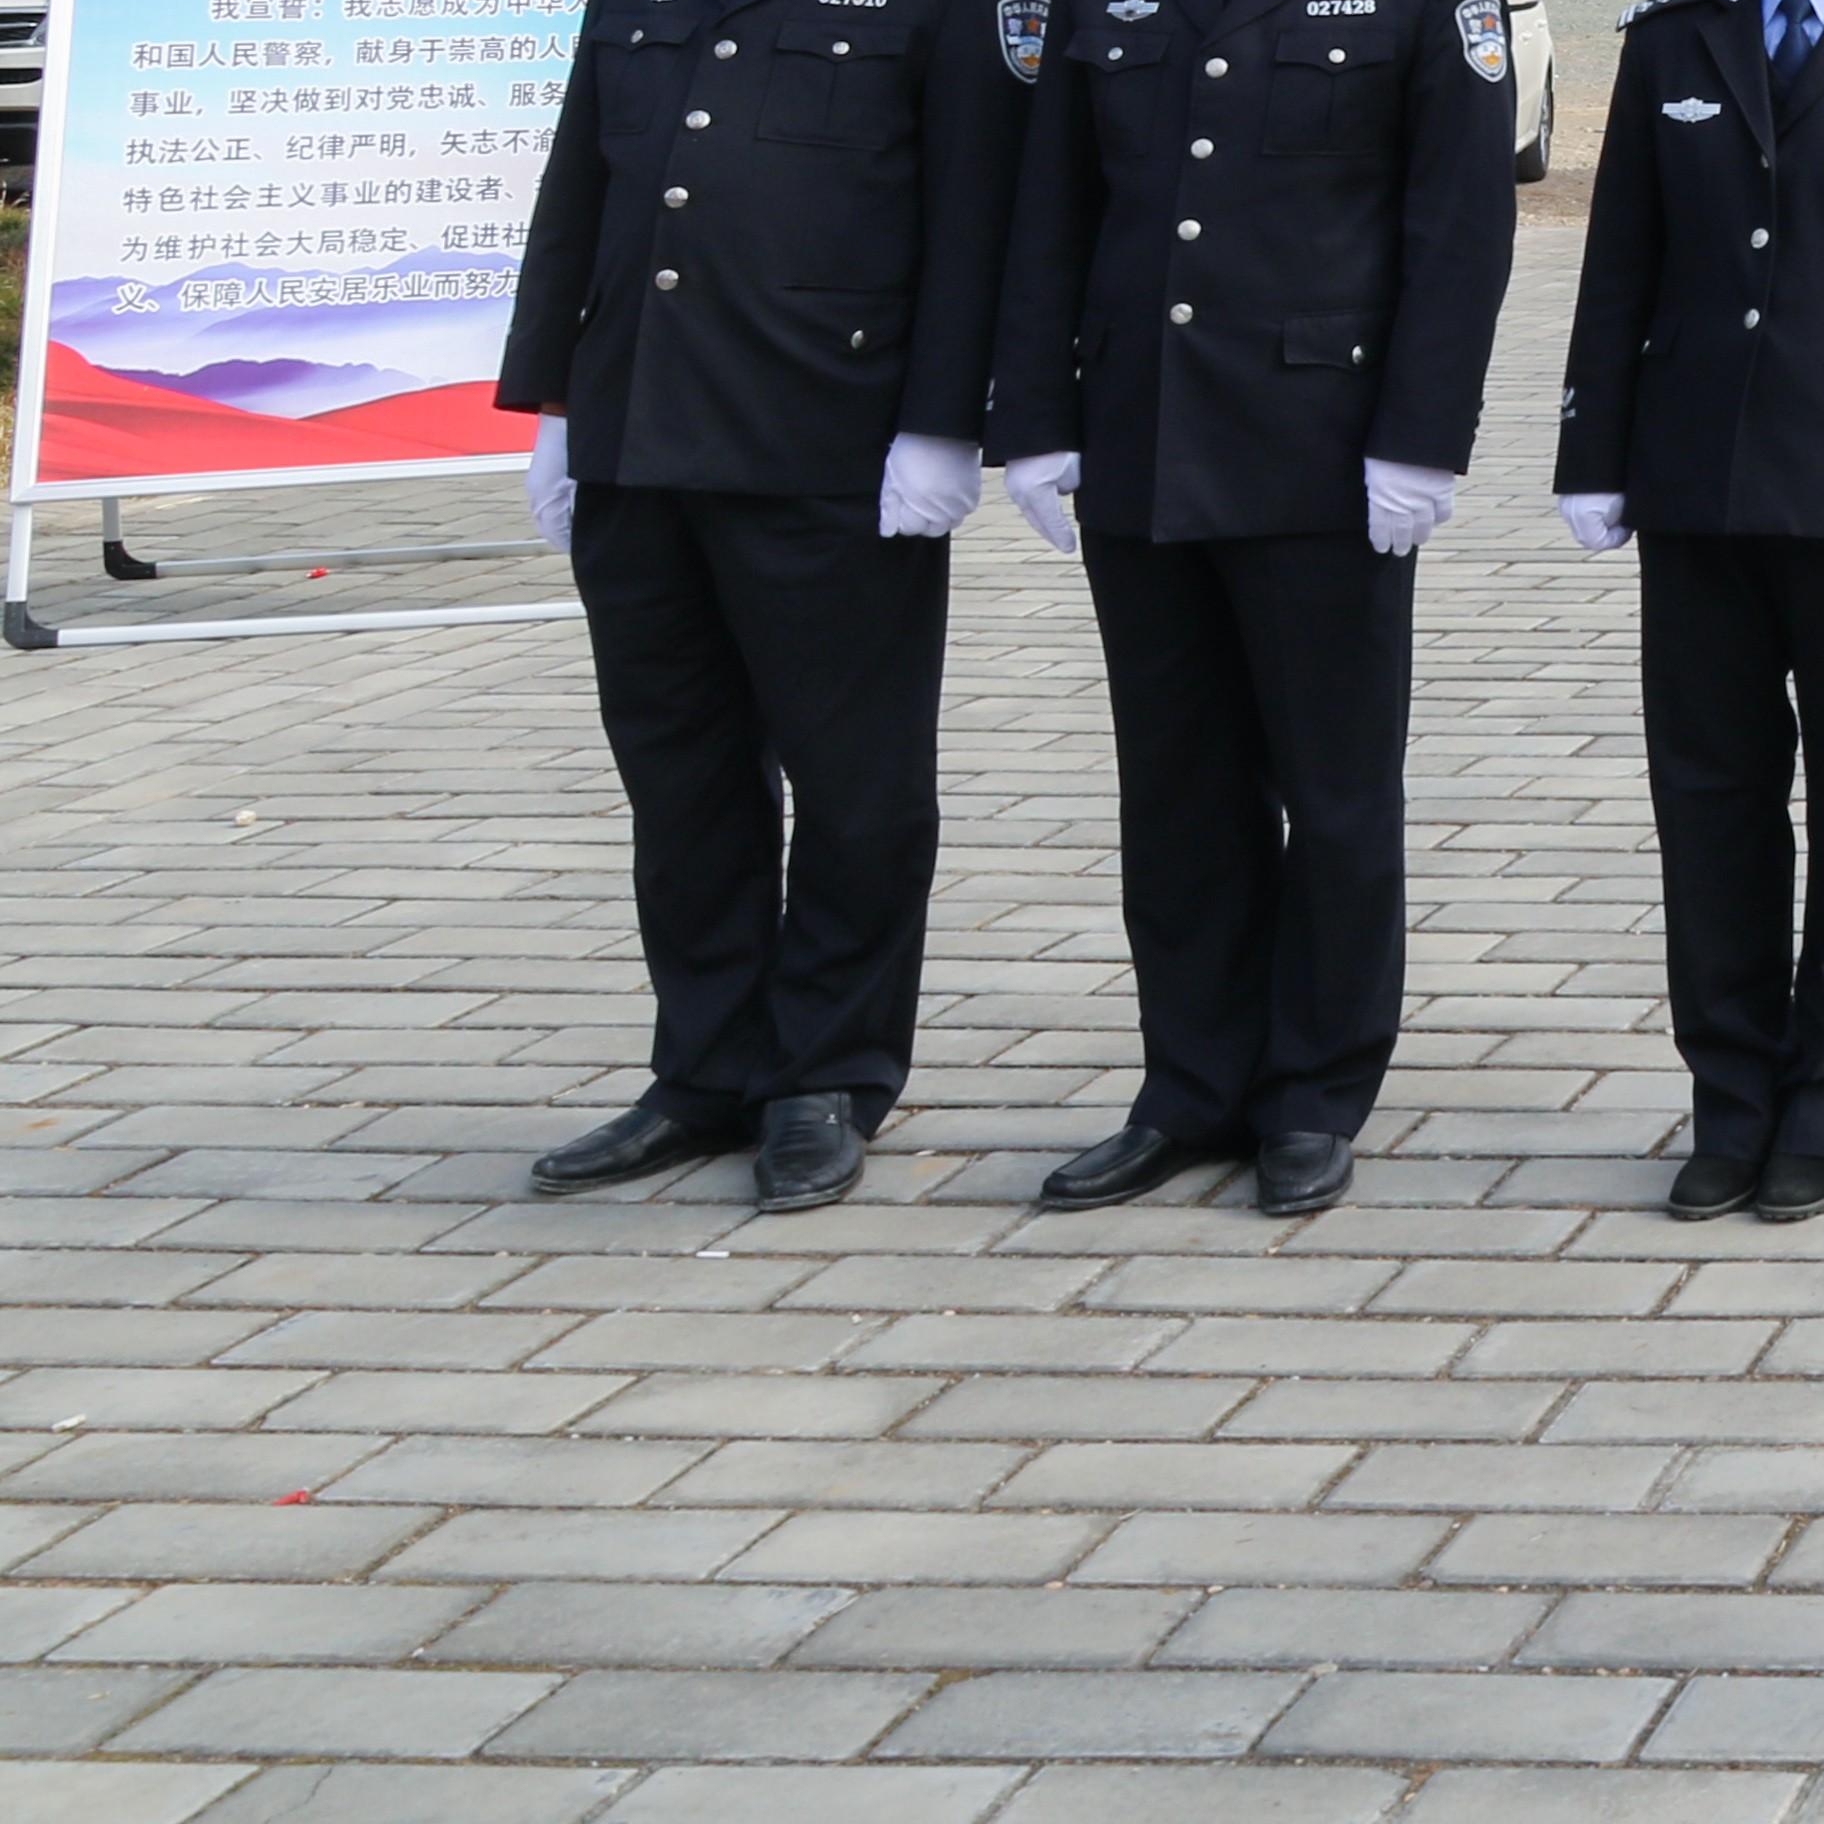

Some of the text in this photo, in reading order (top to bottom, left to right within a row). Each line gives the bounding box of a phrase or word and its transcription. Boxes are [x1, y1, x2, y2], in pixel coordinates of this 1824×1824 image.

[1306, 0, 1377, 16] 027428
[133, 36, 580, 69] 和国人民警察，献身于崇高的人
[122, 176, 542, 213] 特色社会主义事业的建设者、
